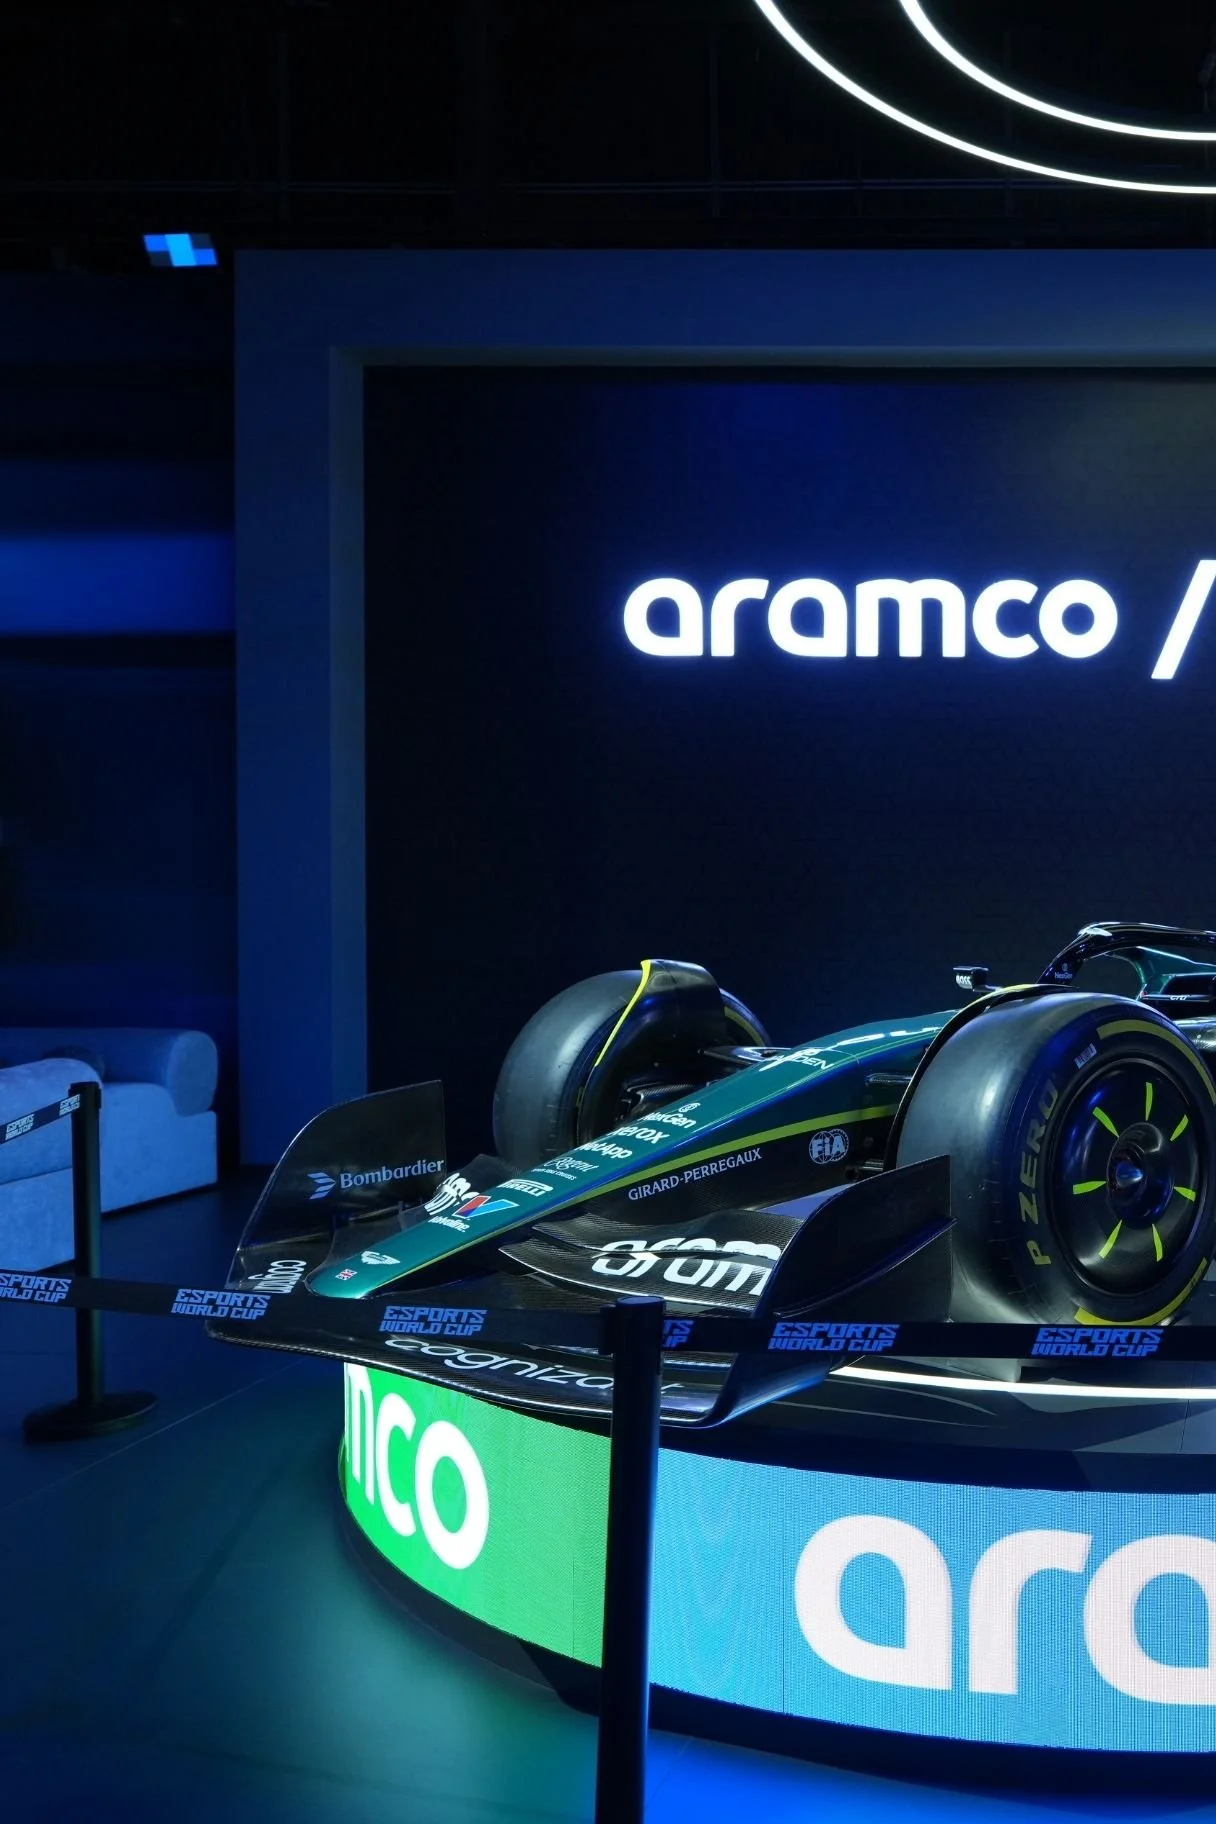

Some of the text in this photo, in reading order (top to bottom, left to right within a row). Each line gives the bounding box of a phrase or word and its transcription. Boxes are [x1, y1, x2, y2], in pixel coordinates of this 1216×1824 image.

[623, 577, 1118, 659] aramco
[340, 1159, 444, 1189] Bombardier
[628, 1148, 762, 1200] GIRARD-PERREGAUX
[1019, 1079, 1059, 1266] P ZERO
[591, 1237, 782, 1296] aram
[0, 1273, 72, 1292] SPORTS
[0, 1287, 67, 1303] RLD CUP
[175, 1288, 271, 1309] ESPORTS
[171, 1303, 266, 1320] WORLD CUP
[383, 1305, 488, 1324] ESPORTS
[379, 1320, 482, 1336] WORLD CUP
[773, 1322, 900, 1339] ESPORTS
[1036, 1327, 1164, 1344] ESPORTS
[767, 1338, 894, 1352] WORLD CUP
[1031, 1343, 1158, 1357] WORLD CUP
